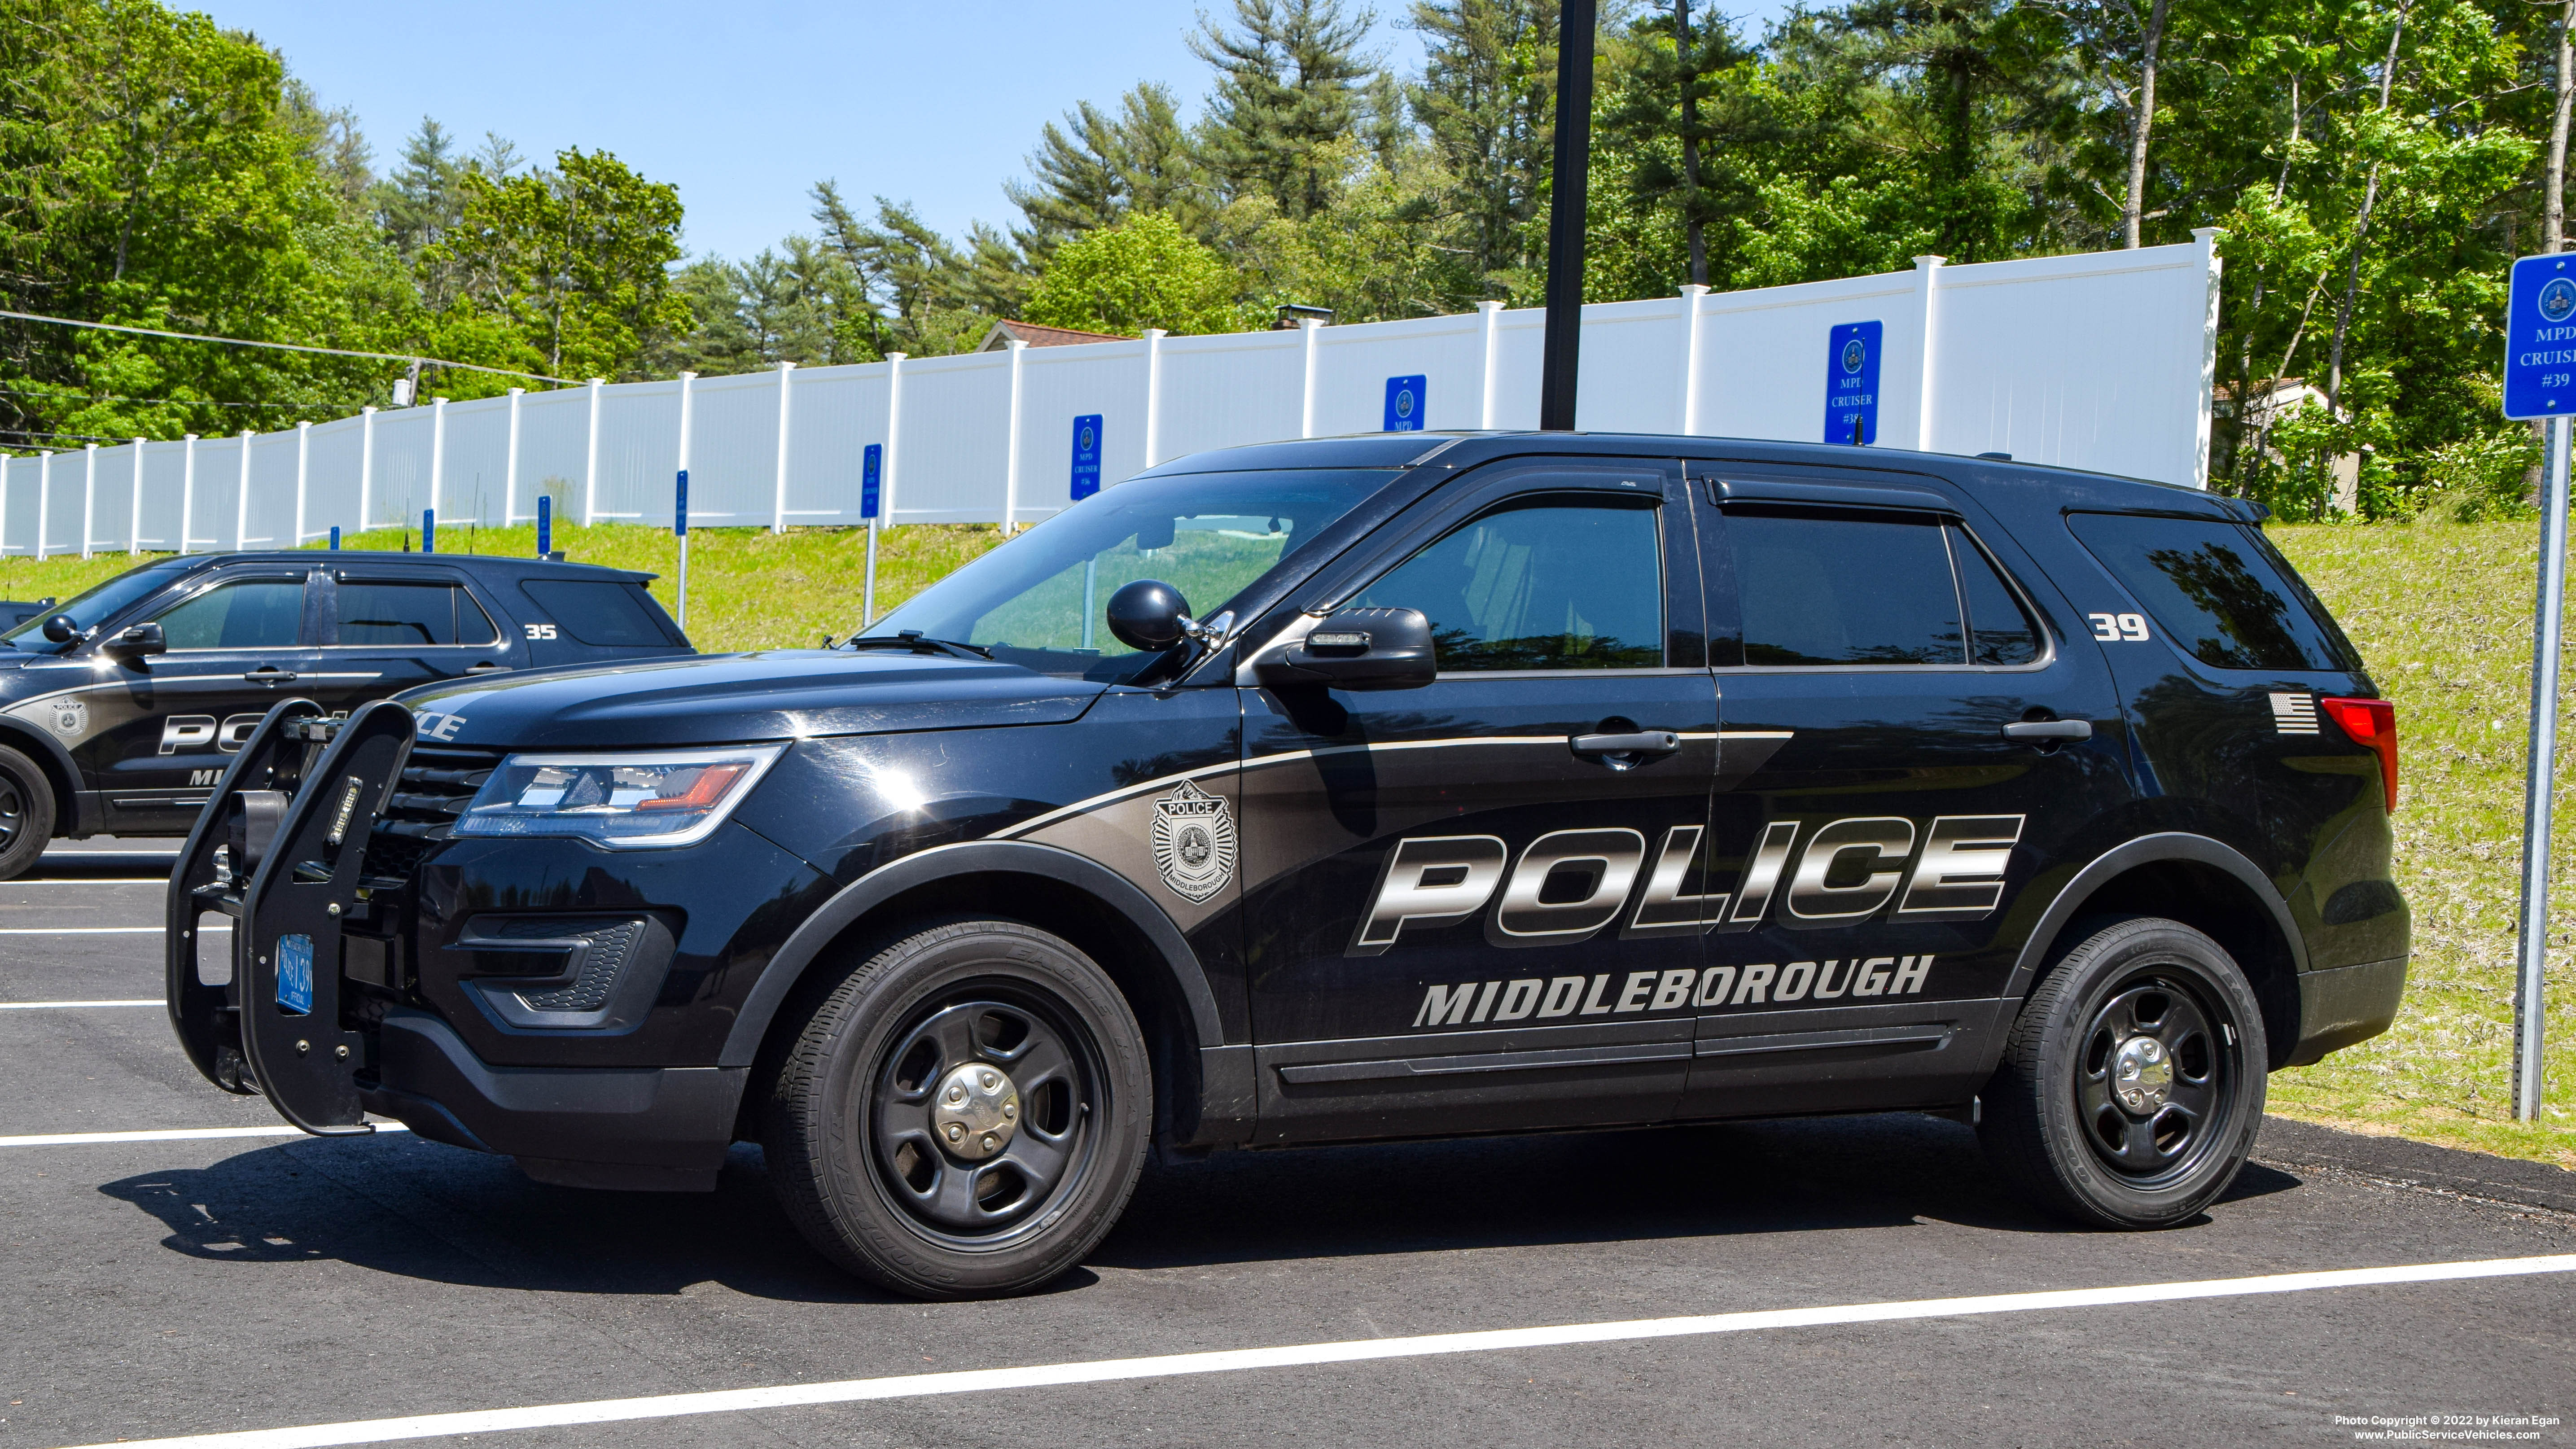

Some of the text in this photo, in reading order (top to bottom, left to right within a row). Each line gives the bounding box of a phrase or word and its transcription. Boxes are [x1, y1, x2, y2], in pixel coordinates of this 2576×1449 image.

[2535, 326, 2576, 342] MPD
[2541, 373, 2570, 387] #39
[1832, 394, 1872, 407] CRUISER
[1395, 420, 1412, 431] MPD
[1075, 465, 1098, 473] CRUISER
[524, 624, 557, 640] 35
[2089, 613, 2150, 642] 39
[1168, 802, 1213, 815] POLICE
[1168, 871, 1225, 892] MIDDLEBOROUGH
[1356, 814, 2027, 947] POLICE
[1006, 944, 1113, 1017] EAGLE
[1412, 954, 1935, 1028] MIDDLEBOROUGH
[830, 1112, 963, 1284] GOODYEAR
